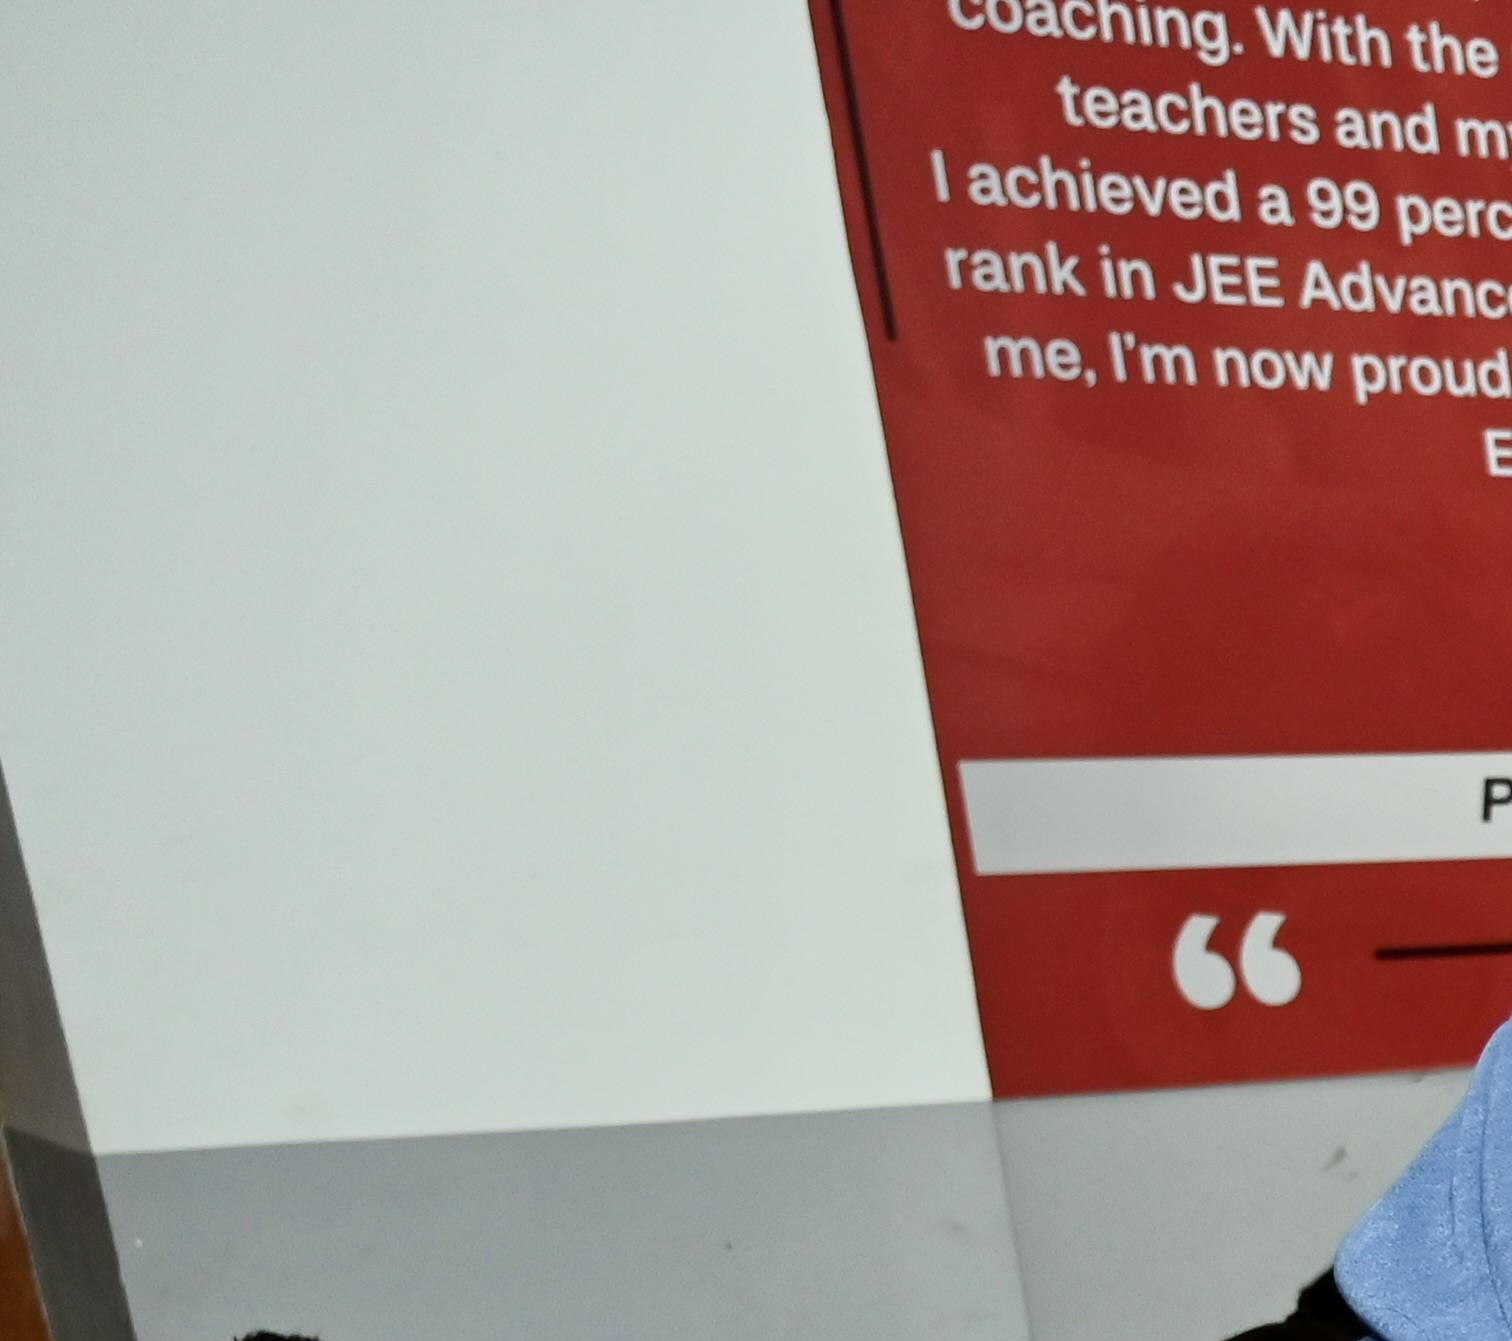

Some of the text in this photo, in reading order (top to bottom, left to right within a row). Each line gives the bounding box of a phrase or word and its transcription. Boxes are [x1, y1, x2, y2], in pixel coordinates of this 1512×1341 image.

[1255, 6, 1392, 68] With
[1405, 21, 1498, 78] the
[1056, 76, 1320, 144] teachers
[1335, 103, 1439, 154] and
[931, 150, 949, 201] I
[968, 155, 1241, 221] achieved
[1258, 184, 1295, 226] a
[1306, 177, 1379, 231] 99
[945, 241, 1085, 296] rank
[1099, 244, 1155, 300] in
[1173, 253, 1284, 307] JEE
[984, 336, 1096, 387] me,
[1109, 332, 1197, 385] I'm
[1213, 348, 1333, 391] now
[1351, 348, 1512, 405] proud
